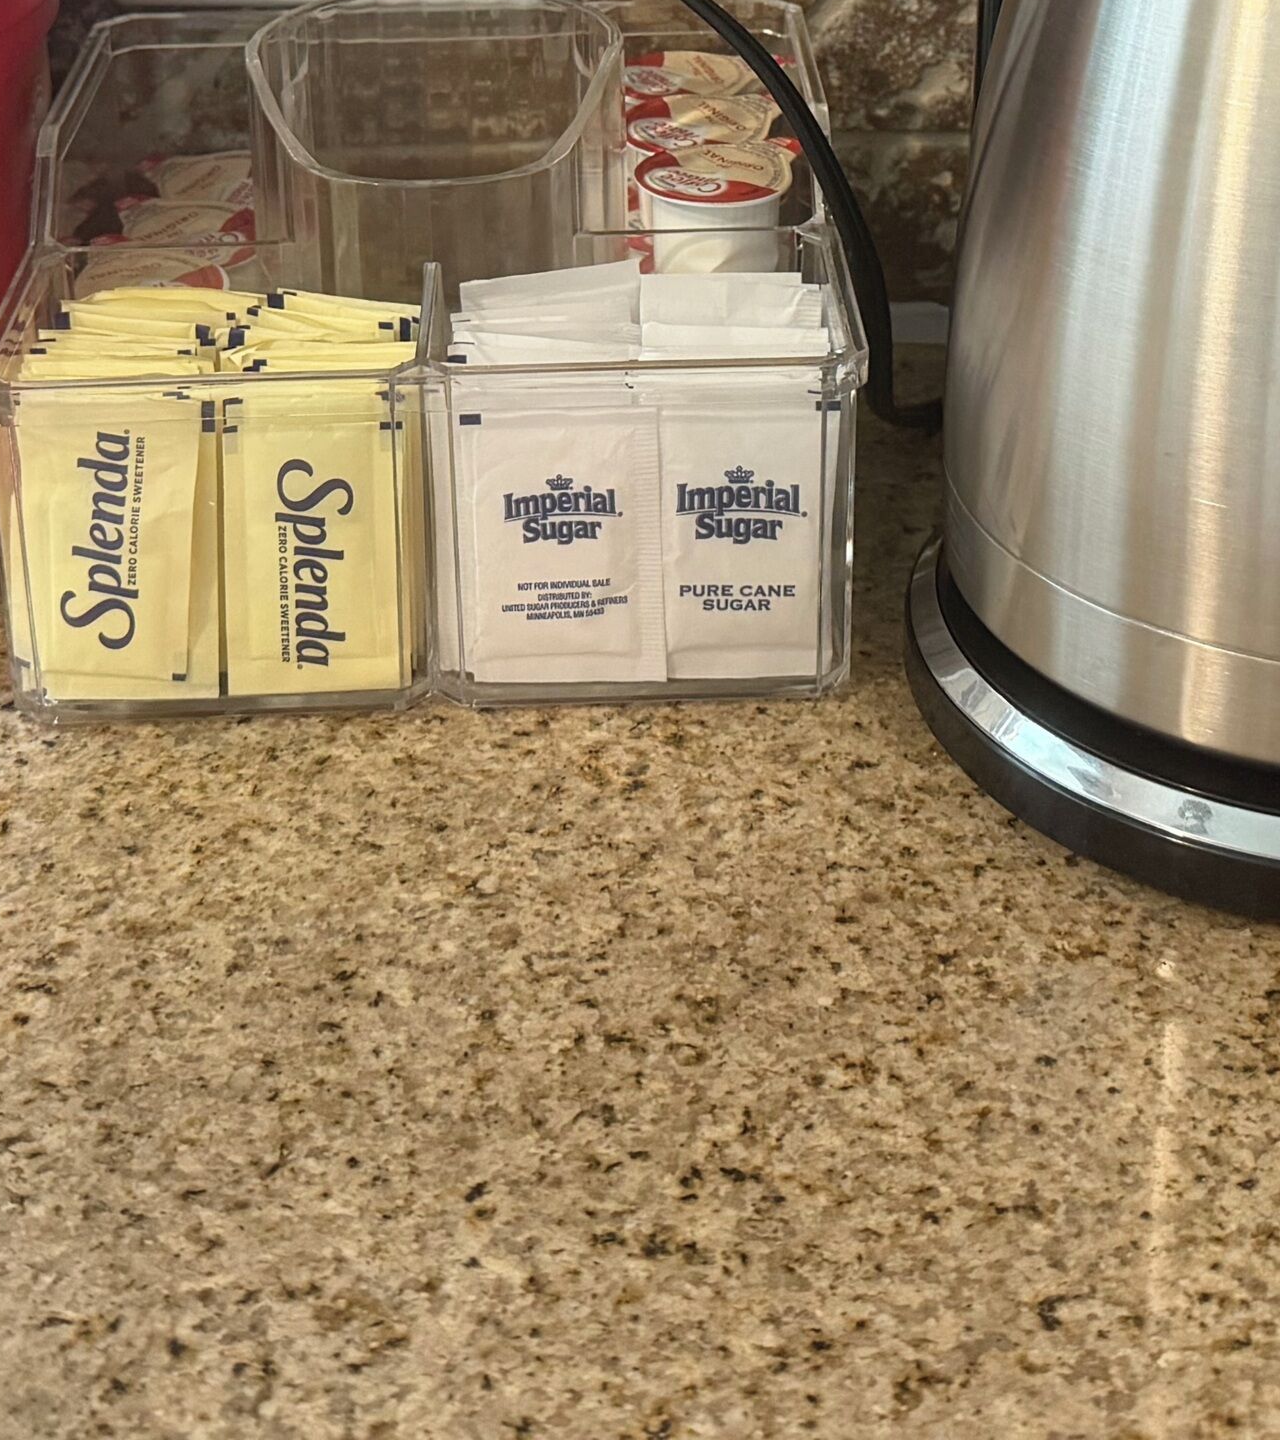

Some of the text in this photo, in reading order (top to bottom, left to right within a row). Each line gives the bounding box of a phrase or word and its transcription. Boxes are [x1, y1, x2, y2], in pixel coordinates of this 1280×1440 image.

[128, 436, 146, 586] ZERO CALORIE SWEETENER
[503, 488, 617, 523] Imperial
[676, 480, 800, 517] Imperial
[60, 431, 139, 649] Splenda
[522, 518, 602, 545] Sugar
[695, 512, 783, 545] Sugar
[275, 458, 354, 668] Splenda
[278, 525, 291, 663] ZERO CALORIE SWEETENER
[518, 578, 611, 591] NOT FOR INDIVIDUAL SALE
[538, 592, 580, 601] DISTRIBUTED
[679, 584, 796, 598] PURE CANE
[502, 604, 526, 613] UNITED
[527, 602, 549, 611] SUGAR
[550, 600, 590, 610] PRODUCERS
[597, 595, 628, 606] REFINERS
[702, 598, 771, 611] SUGAR
